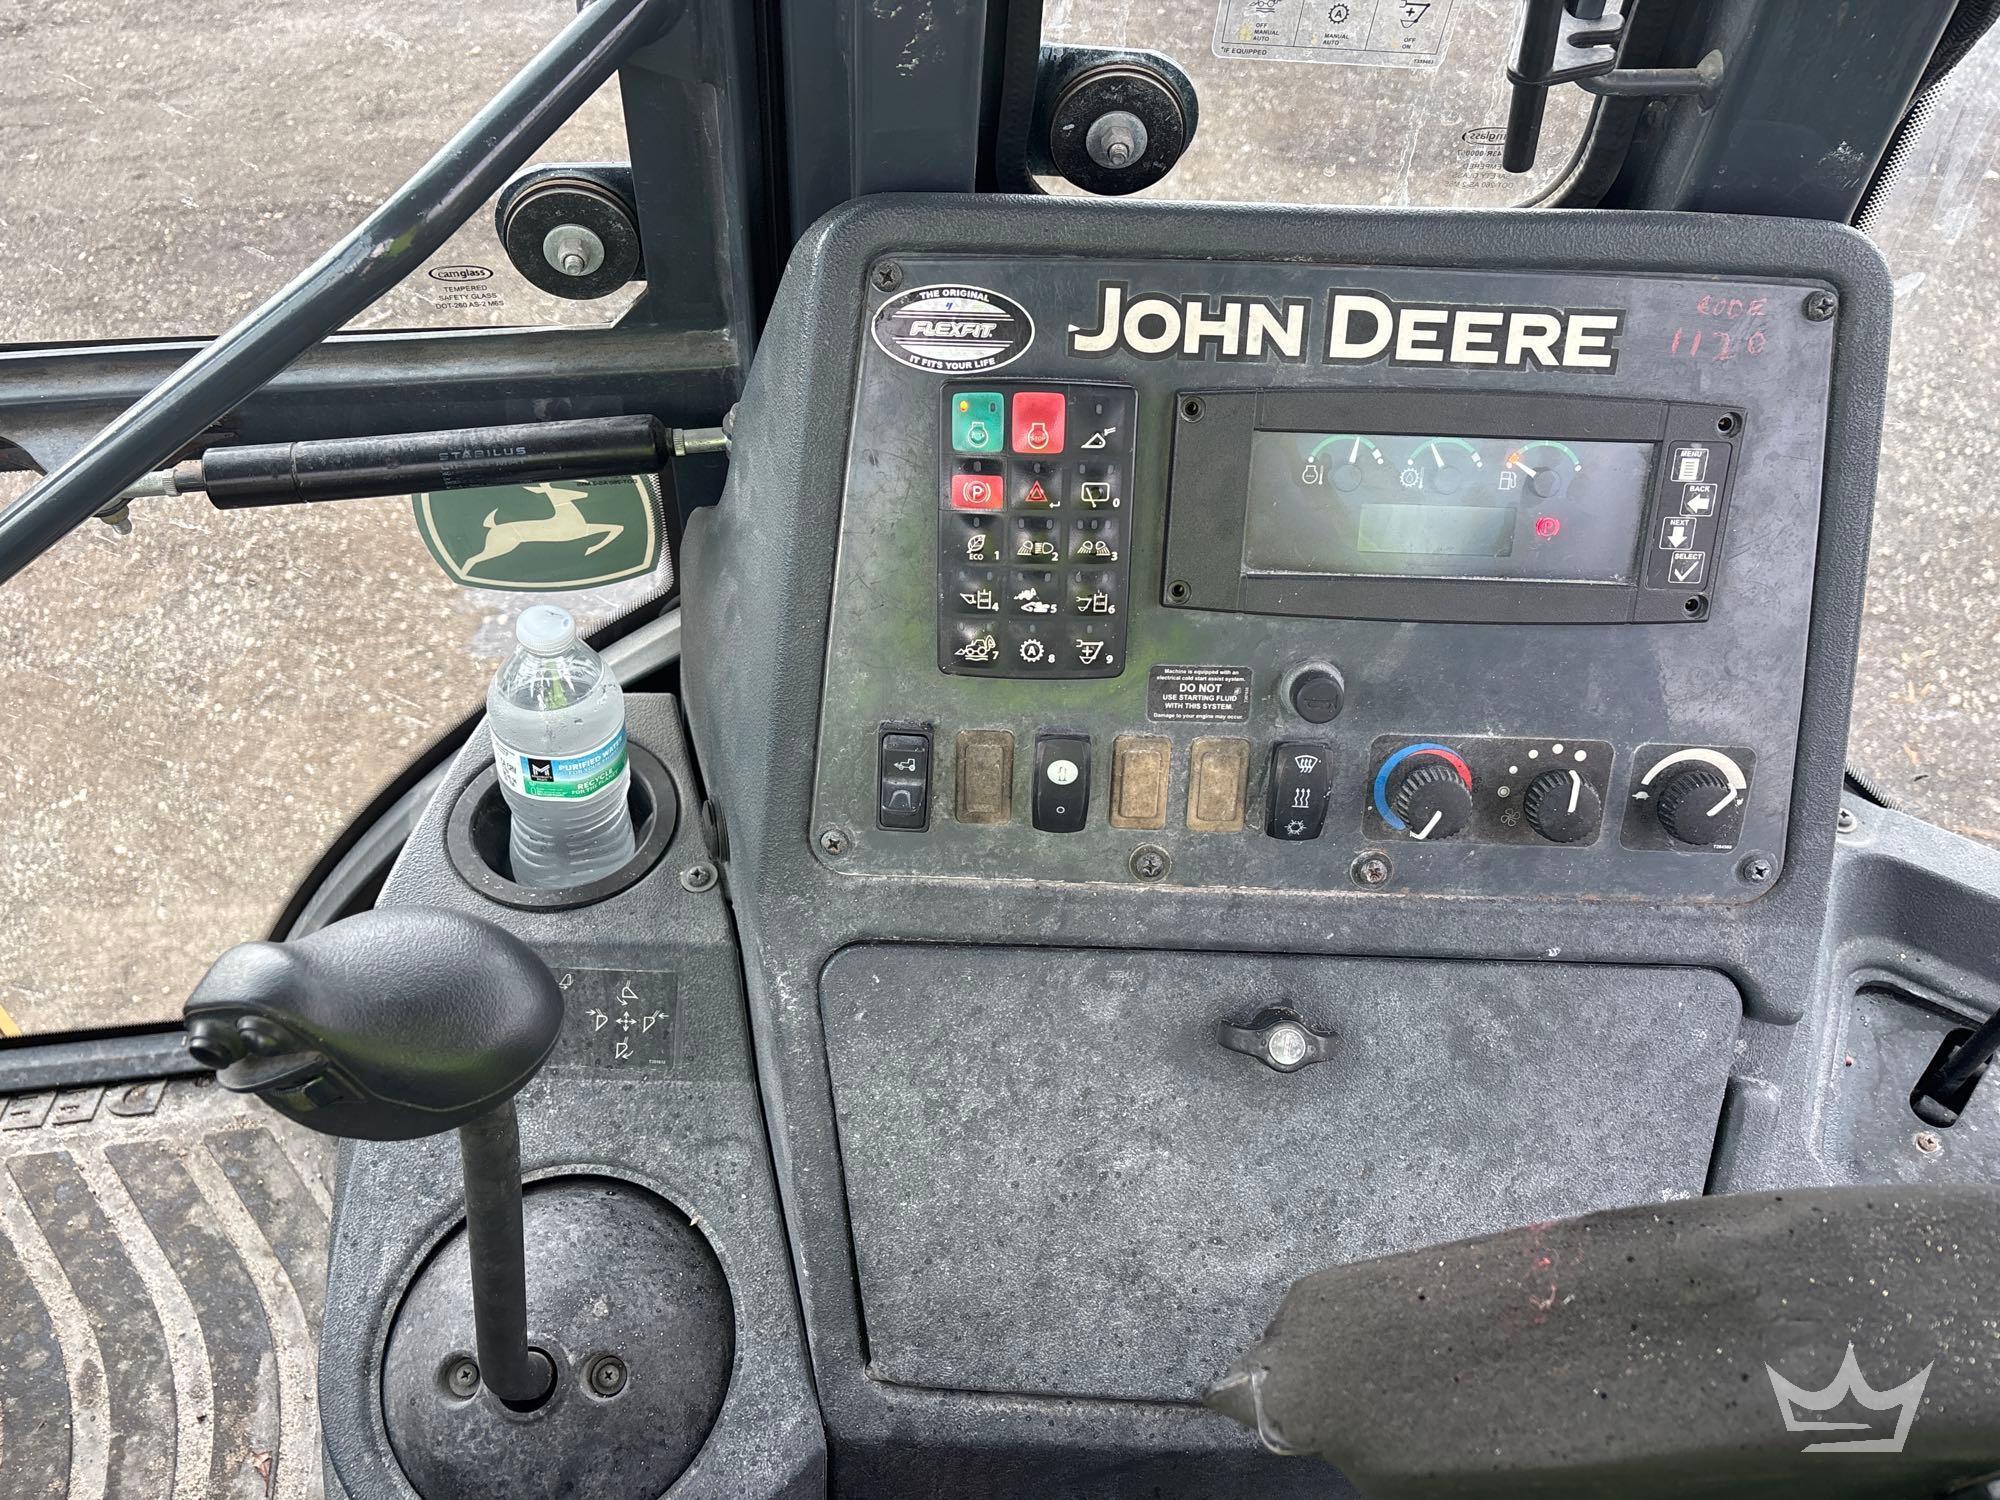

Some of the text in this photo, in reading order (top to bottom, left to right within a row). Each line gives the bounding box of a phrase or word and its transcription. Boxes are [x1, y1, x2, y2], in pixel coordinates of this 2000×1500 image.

[1231, 47, 1267, 56] EQUIPPED
[437, 268, 486, 278] camglass
[443, 285, 488, 293] TEMPERED
[919, 289, 990, 303] THE ORIGINAL
[1073, 286, 1619, 368] JOHN DEERE
[909, 354, 996, 370] IT FITS YOUR LIFE
[438, 446, 526, 461] STABILUS
[1112, 498, 1120, 508] 0
[994, 551, 1000, 560] 1
[1051, 552, 1059, 561] 2
[1111, 552, 1118, 561] 3
[992, 602, 1116, 614] 4 5 6
[992, 651, 1000, 660] 7
[1048, 654, 1056, 663] 8
[1105, 654, 1113, 664] 9
[1179, 683, 1222, 693] DO NOT
[558, 756, 601, 771] PURIFIED
[577, 768, 613, 790] RECYCLE
